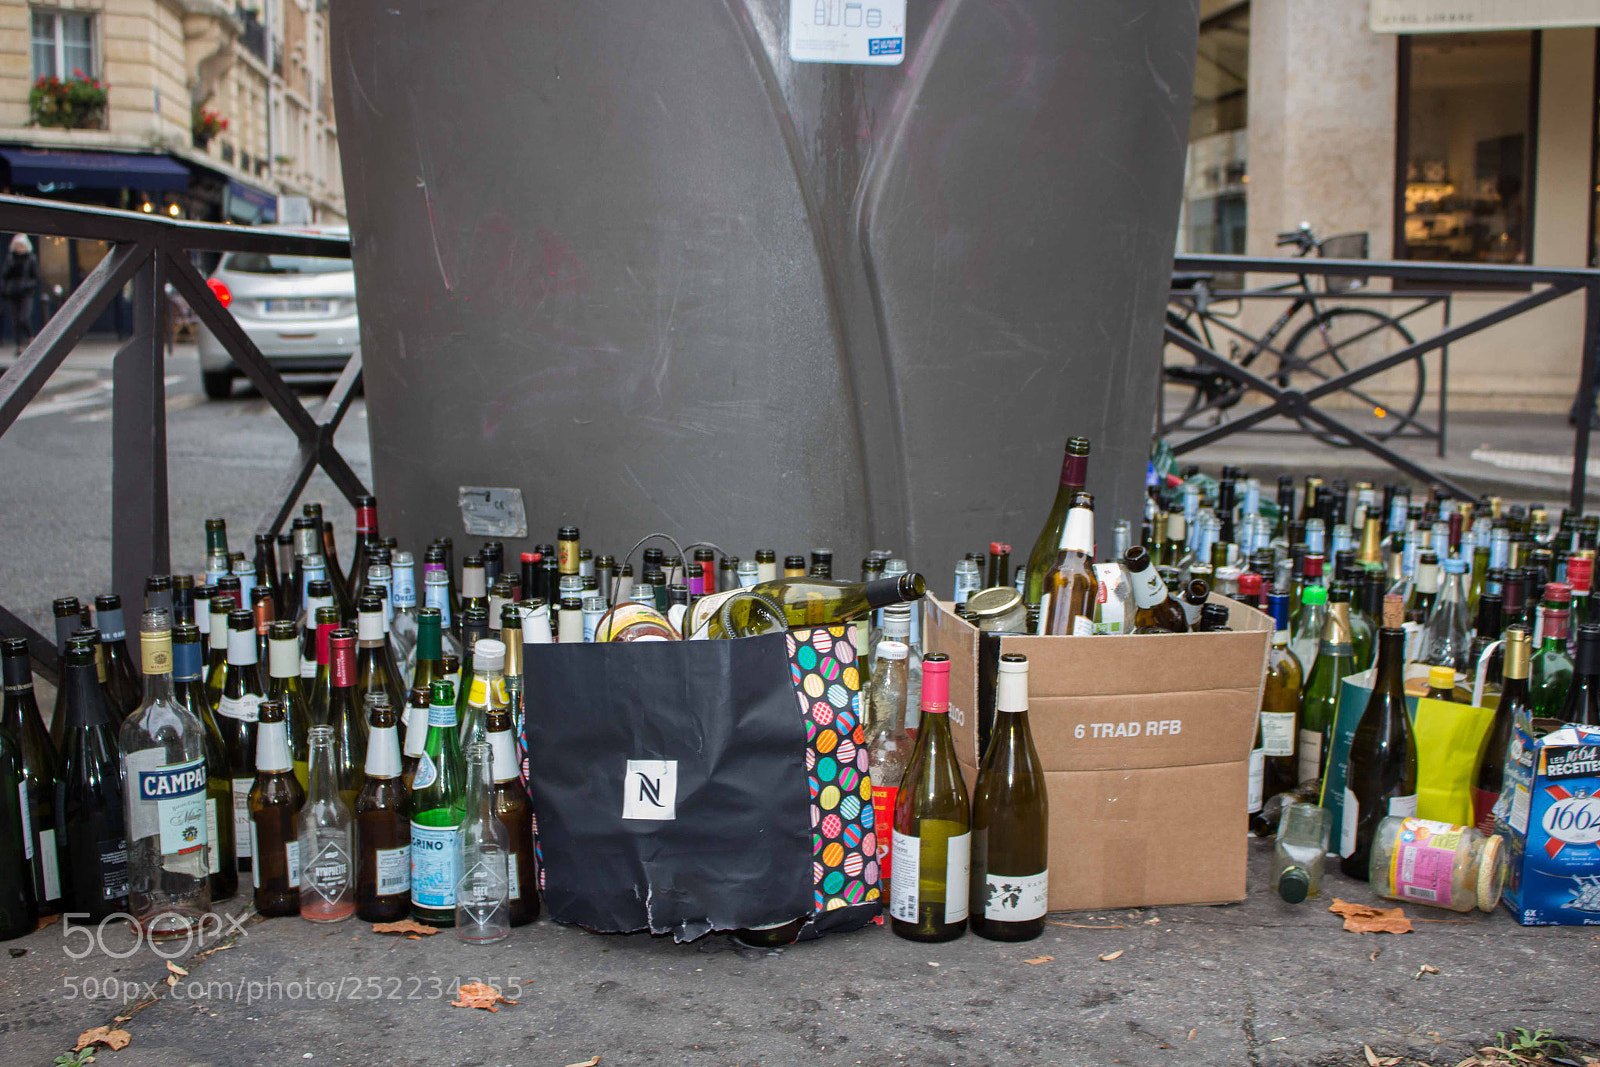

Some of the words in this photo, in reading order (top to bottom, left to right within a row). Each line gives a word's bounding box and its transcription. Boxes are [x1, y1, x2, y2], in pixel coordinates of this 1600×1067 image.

[1074, 723, 1086, 739] 6
[1089, 722, 1141, 739] TRAD
[1145, 719, 1182, 736] RFB
[1549, 756, 1565, 765] LES
[1565, 745, 1598, 763] 1664
[1546, 759, 1600, 777] RECETTE
[634, 772, 666, 808] N
[1549, 802, 1600, 832] 1664
